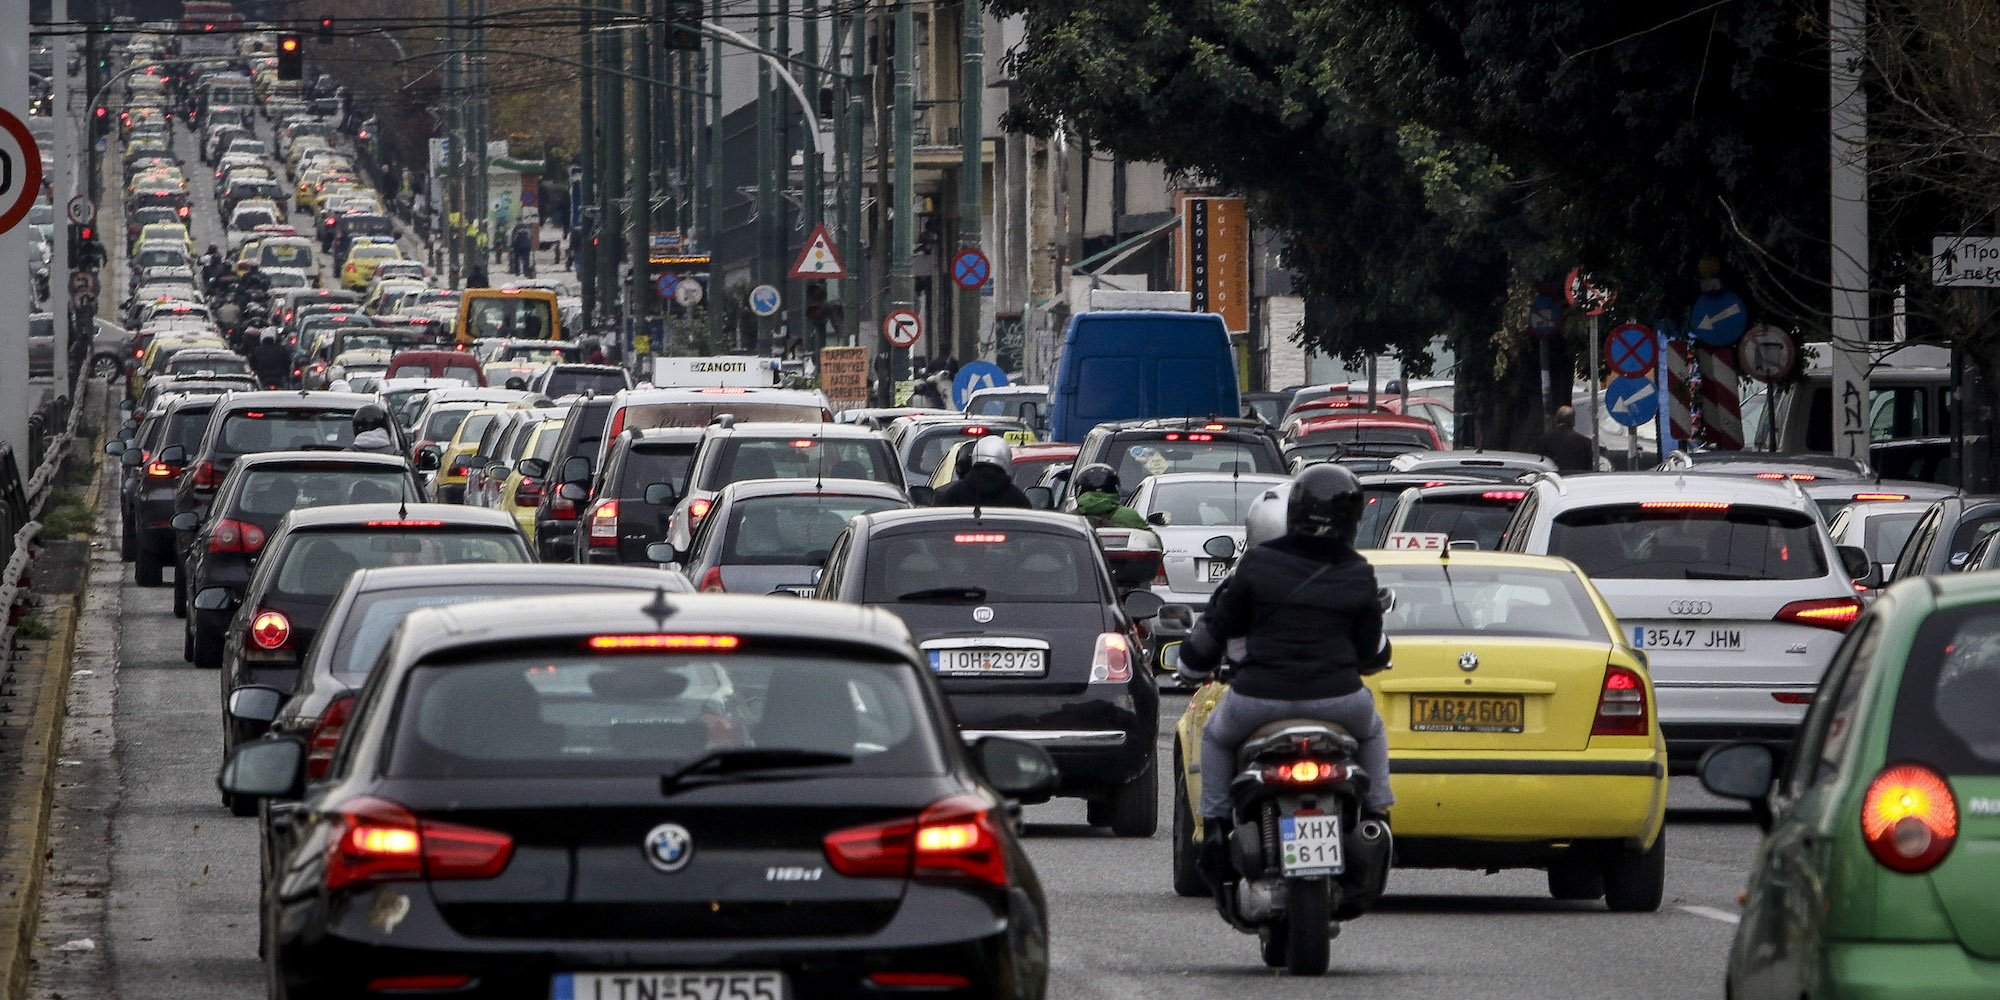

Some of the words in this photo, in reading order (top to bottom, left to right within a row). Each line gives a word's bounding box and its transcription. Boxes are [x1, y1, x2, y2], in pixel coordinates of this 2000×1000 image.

[700, 361, 746, 372] ZANOTTI
[1647, 630, 1696, 648] 3547
[1704, 630, 1741, 648] JHM
[1297, 821, 1337, 840] XHX
[1299, 844, 1339, 863] 611
